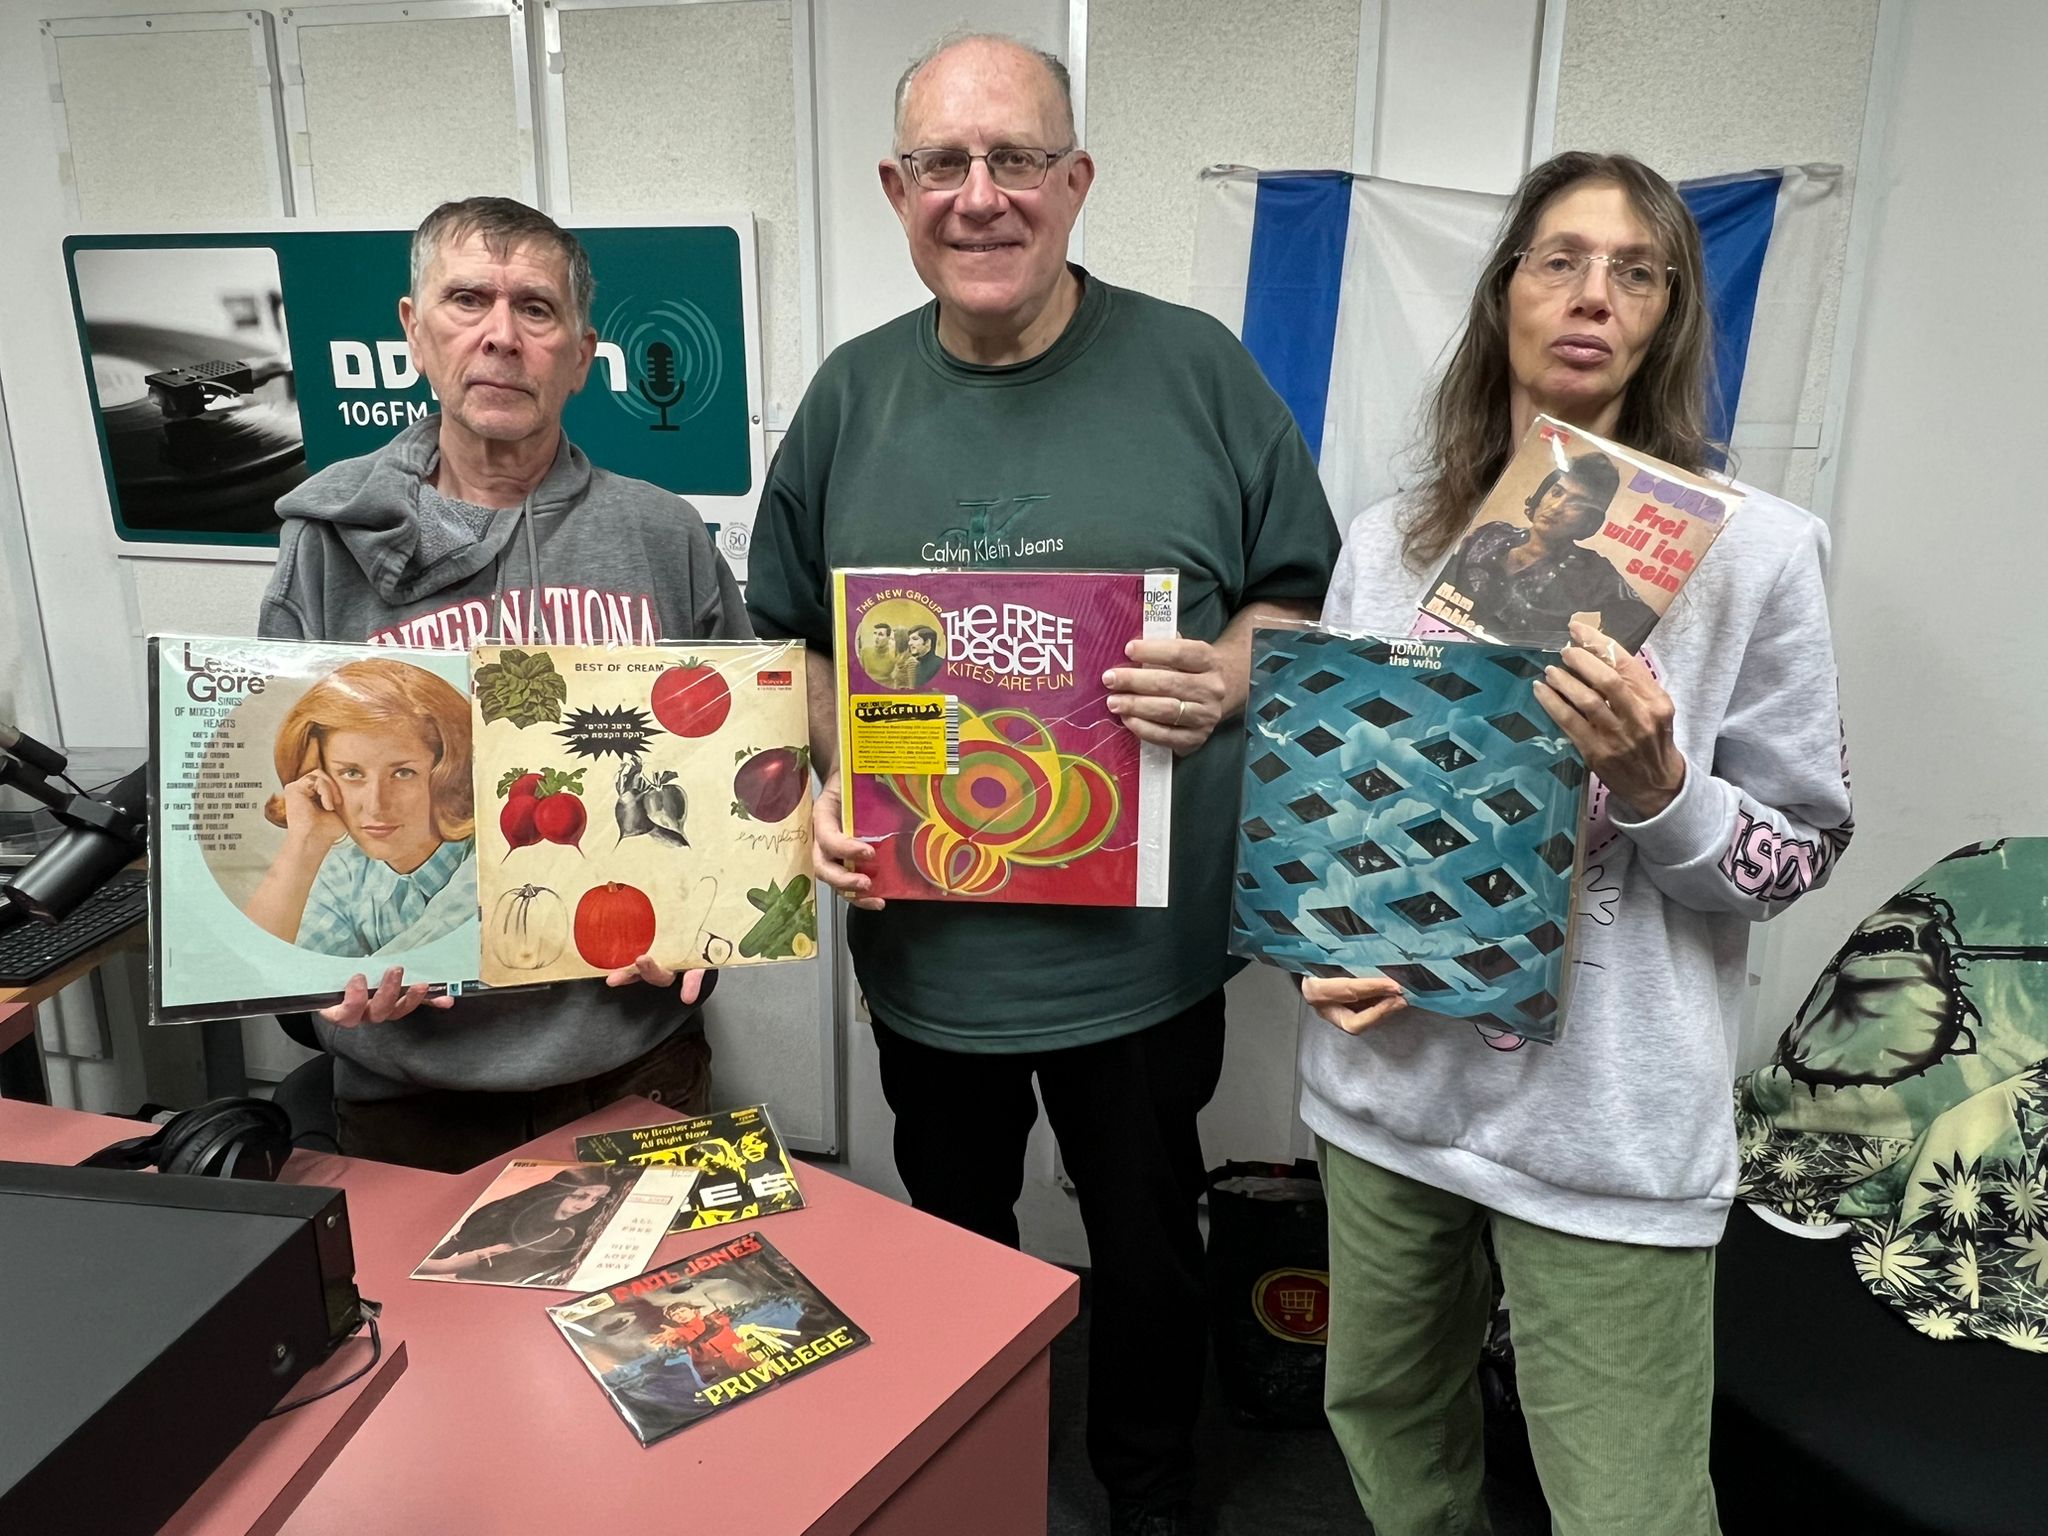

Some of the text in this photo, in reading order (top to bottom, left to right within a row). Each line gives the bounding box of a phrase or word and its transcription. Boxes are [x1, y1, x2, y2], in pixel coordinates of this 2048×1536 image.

[338, 401, 427, 427] 106FM
[1633, 503, 1688, 539] Frei
[730, 531, 747, 546] 50
[921, 536, 1064, 562] Calvin Klein Jeans
[1603, 521, 1695, 573] will ich
[1626, 558, 1680, 593] sein
[856, 588, 943, 615] THE NEW GROUP
[1003, 603, 1074, 644] FREE
[1389, 655, 1442, 670] the who
[1390, 643, 1444, 657] TOMMY
[575, 663, 665, 672] BEST OF CREAM
[947, 663, 1074, 692] KITES ARE FUN
[187, 672, 265, 702] Gore
[174, 707, 230, 717] OF MIXED-UP
[218, 697, 242, 706] SINGS
[203, 719, 236, 728] HEARTS
[632, 1120, 713, 1140] My Brother Jake
[641, 1130, 709, 1149] All Right Now
[684, 1236, 762, 1277] JONES
